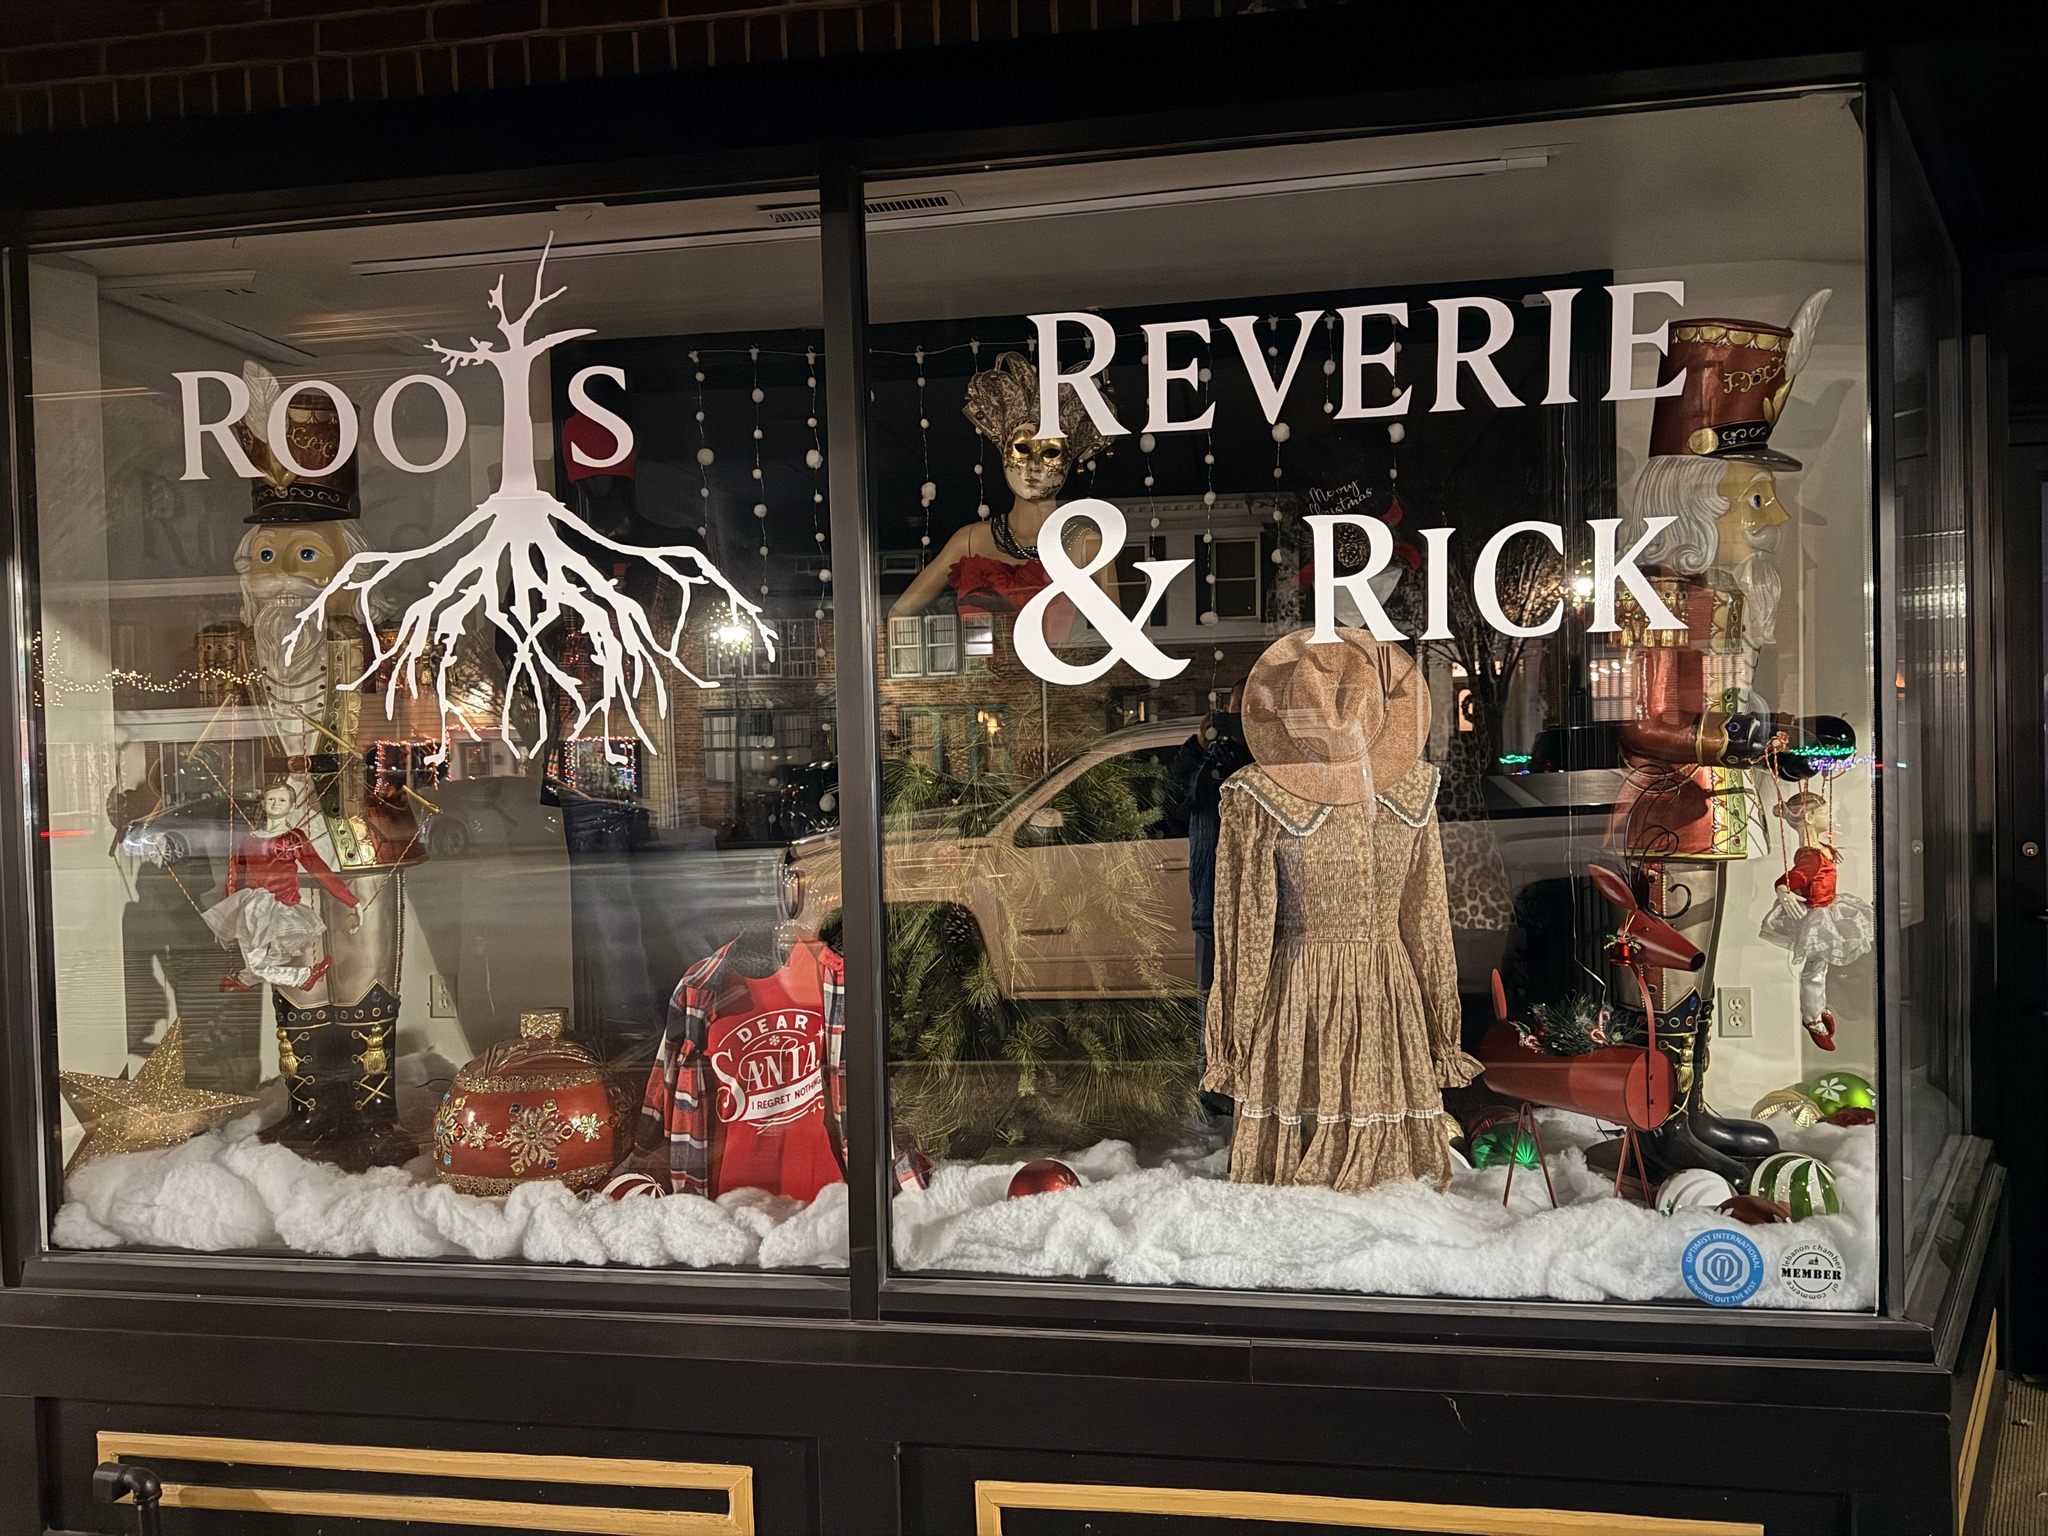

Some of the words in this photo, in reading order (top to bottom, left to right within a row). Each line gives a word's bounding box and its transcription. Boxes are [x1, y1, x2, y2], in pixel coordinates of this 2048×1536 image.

[1027, 281, 1688, 440] REVERIE
[172, 364, 636, 482] ROOTS
[1308, 480, 1360, 502] Merry
[1013, 498, 1195, 686] &
[1302, 514, 1689, 644] RICK
[736, 1014, 809, 1044] DEAR
[751, 1101, 755, 1110] I
[757, 1093, 791, 1110] REGRET
[1686, 1235, 1711, 1263] OPTIMIST
[1713, 1233, 1760, 1269] INTERNATIONAL
[1782, 1245, 1809, 1267] lebanon
[1813, 1244, 1842, 1269] chamber
[1781, 1268, 1841, 1280] MEMBER
[1687, 1275, 1714, 1300] BRINGING
[1731, 1292, 1744, 1302] THE
[1744, 1281, 1756, 1295] BEST
[1787, 1281, 1826, 1299] commerce
[1832, 1283, 1838, 1293] of
